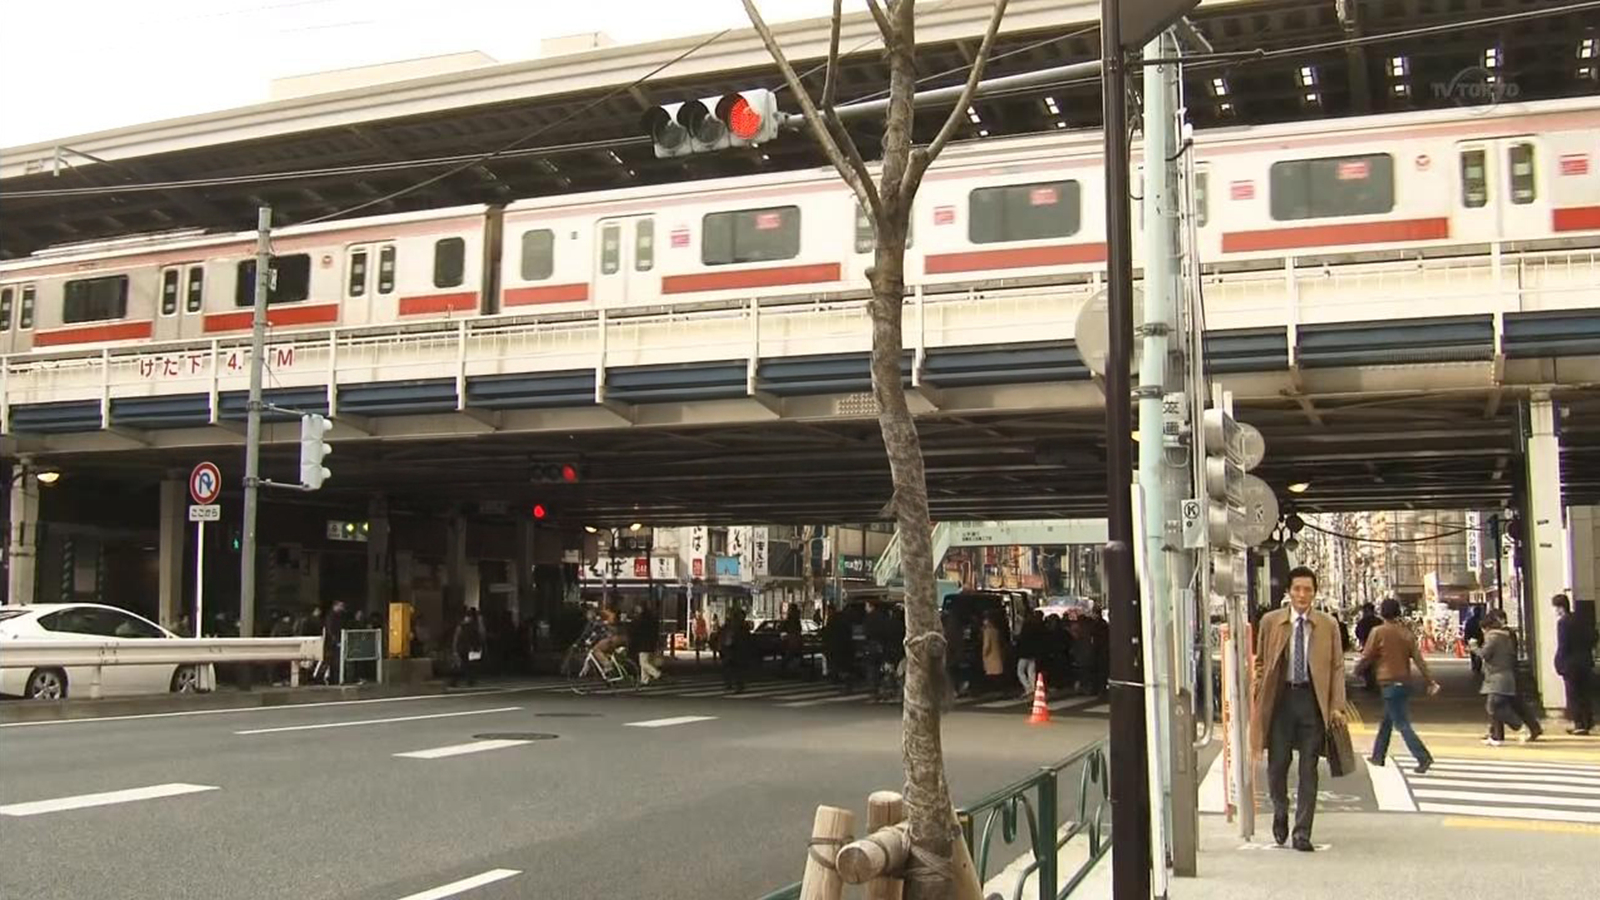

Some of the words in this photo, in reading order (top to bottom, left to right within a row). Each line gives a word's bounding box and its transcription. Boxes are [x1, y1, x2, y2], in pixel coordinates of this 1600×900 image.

[140, 354, 202, 378] けた下
[191, 508, 219, 518] ここから
